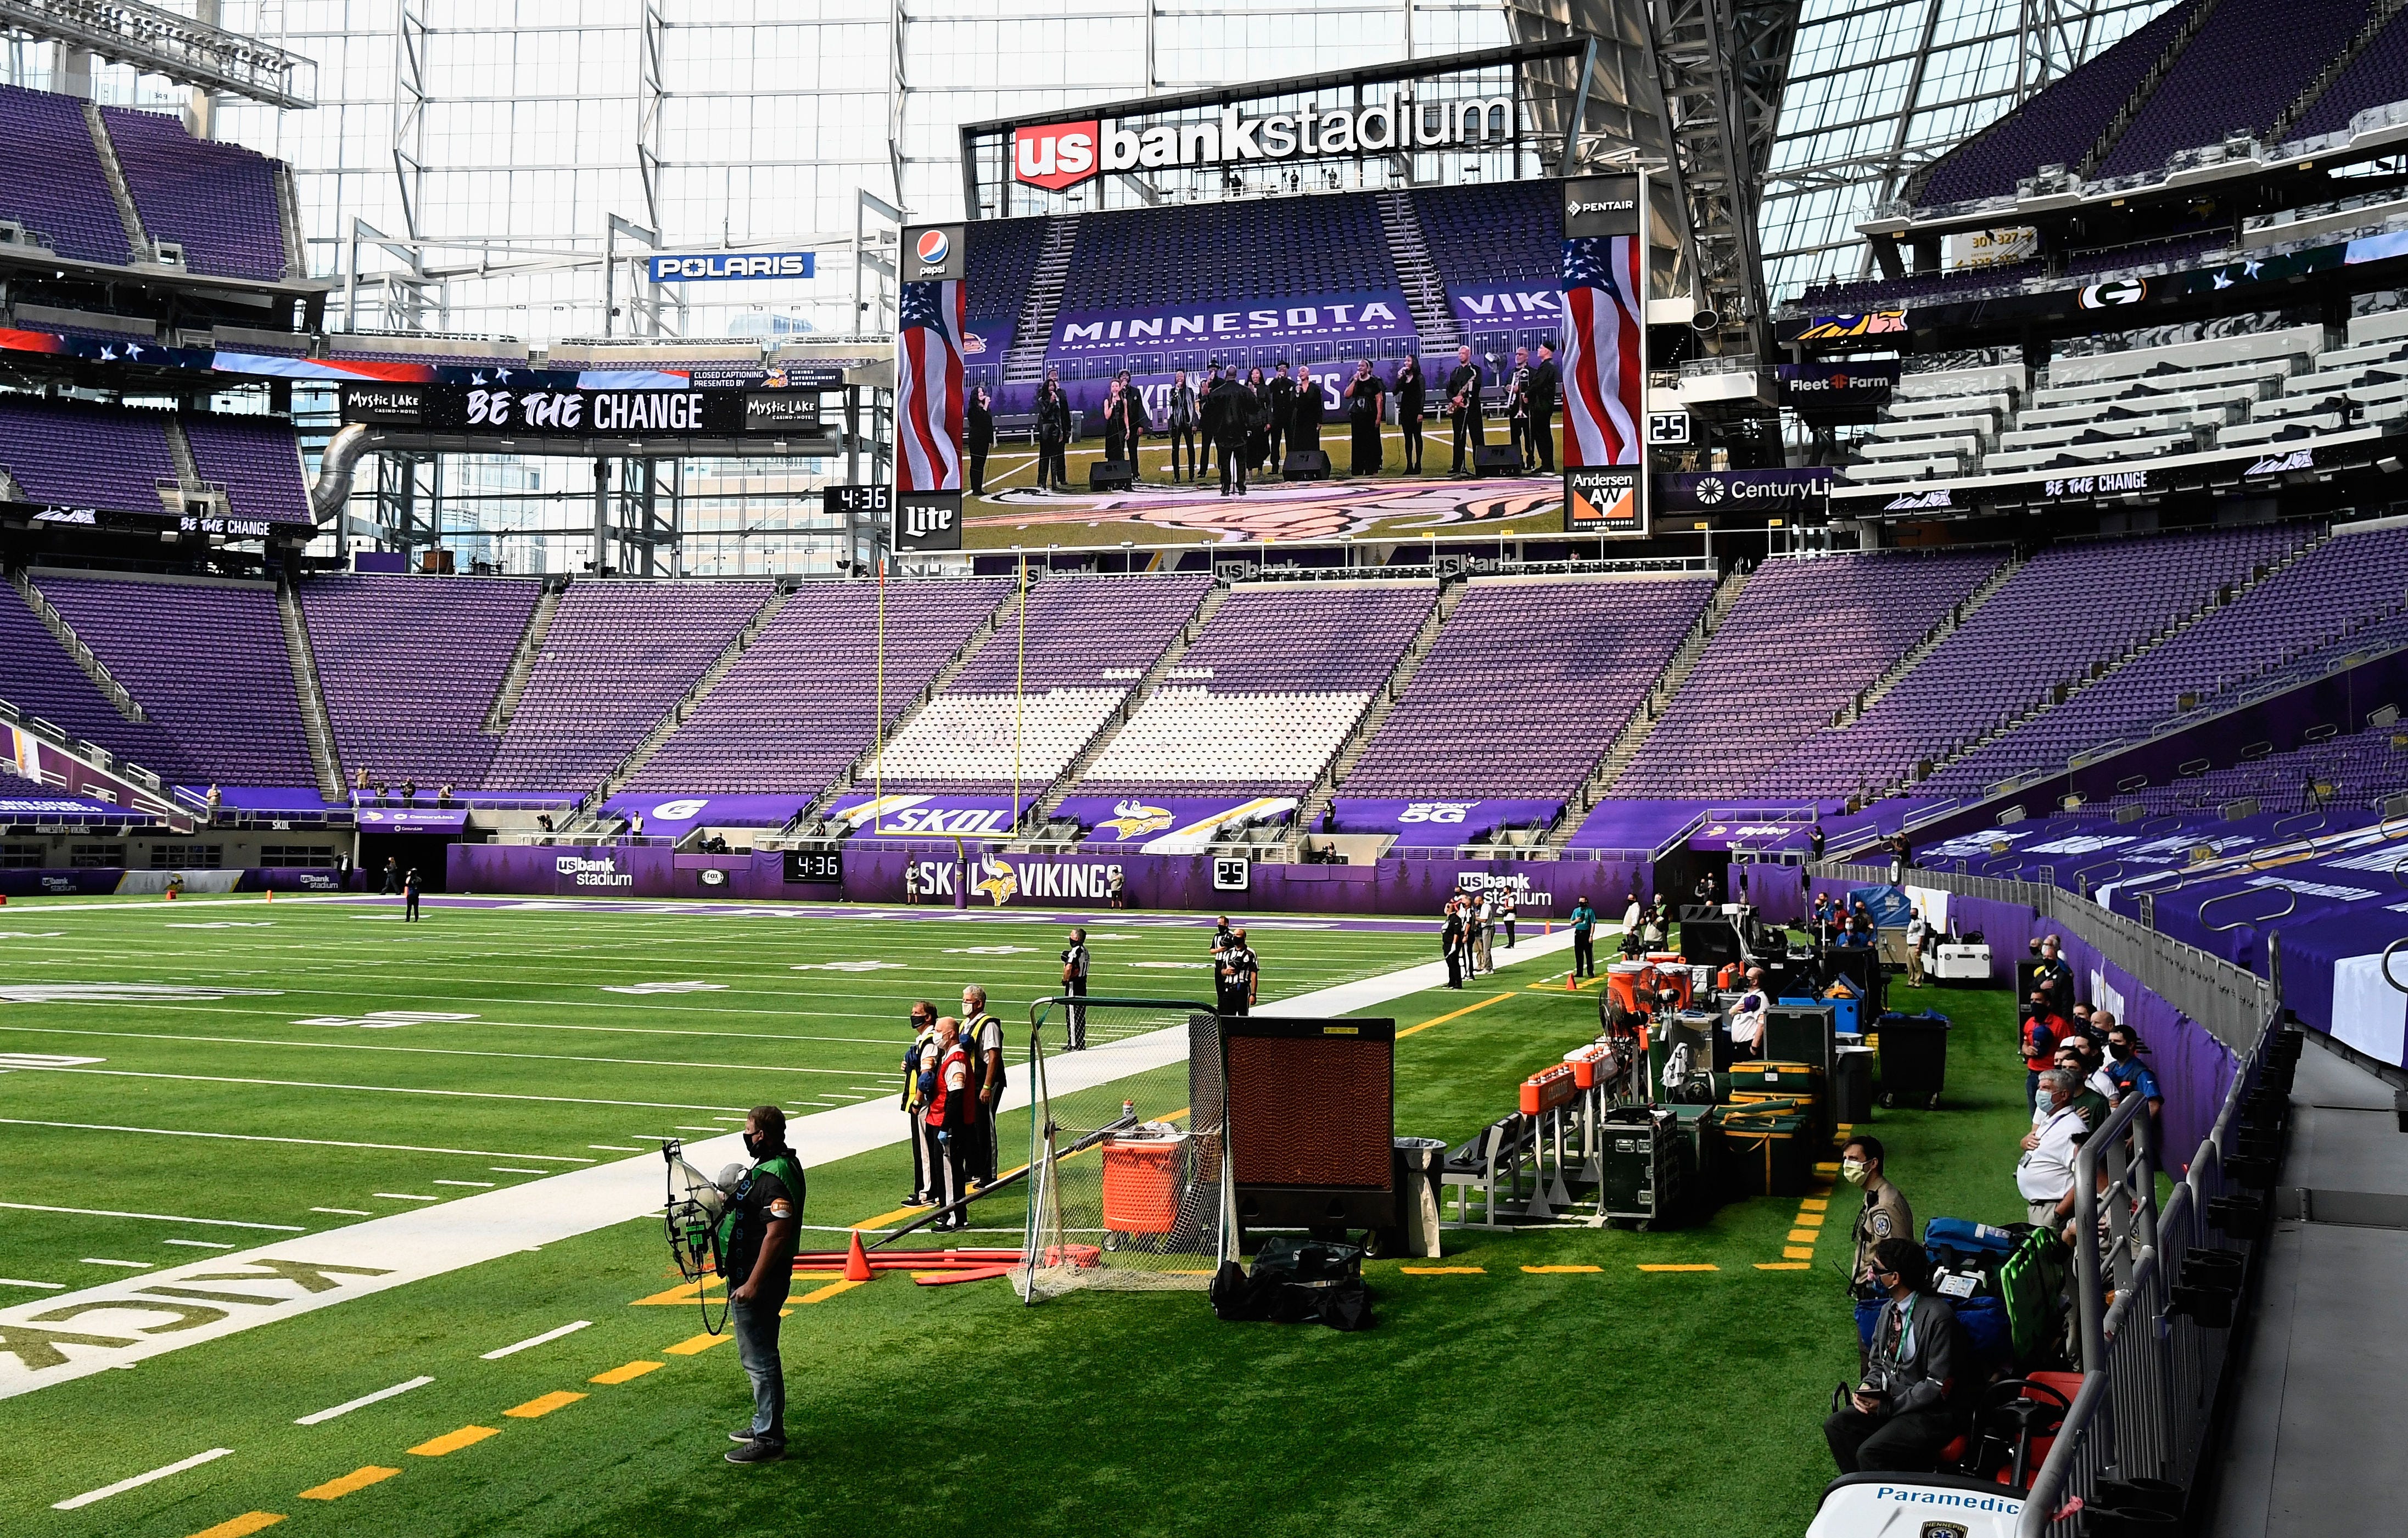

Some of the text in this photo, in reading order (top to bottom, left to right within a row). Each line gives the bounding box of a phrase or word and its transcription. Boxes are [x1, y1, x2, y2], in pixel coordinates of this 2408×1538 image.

[1018, 91, 1514, 177] us bank stadium
[1582, 200, 1633, 212] PENTAIR
[1972, 232, 2019, 248] 301327
[658, 256, 804, 278] POLARIS
[919, 264, 945, 276] pepsi
[1062, 301, 1397, 342] MINNESOTA
[1059, 342, 1125, 351] THANK
[1272, 327, 1356, 336] HEROES
[693, 379, 736, 388] PRESENTED
[721, 371, 764, 379] CAPTIONING
[1790, 374, 1889, 391] Fleet Farm
[466, 390, 703, 429] BE THE CHANGE
[1652, 416, 1684, 440] 25
[1572, 473, 1633, 487] Andersen
[2045, 470, 2147, 497] BE THE CHANGE
[841, 487, 886, 509] 4:36
[181, 517, 270, 536] BE THE CHANGE
[905, 506, 952, 537] Lite
[272, 821, 290, 830] SKOL
[884, 809, 1010, 832] SKOL
[1397, 809, 1466, 823] 5G
[558, 857, 615, 872] us bank
[798, 857, 837, 875] 4:36
[1219, 863, 1242, 885] 25
[576, 871, 632, 886] stadium
[920, 861, 985, 896] SKL
[1460, 872, 1531, 889] us bank
[0, 1259, 398, 1371] KICK
[1877, 1486, 2021, 1515] Paramedic
[1925, 1522, 1965, 1533] HENNEPIN
